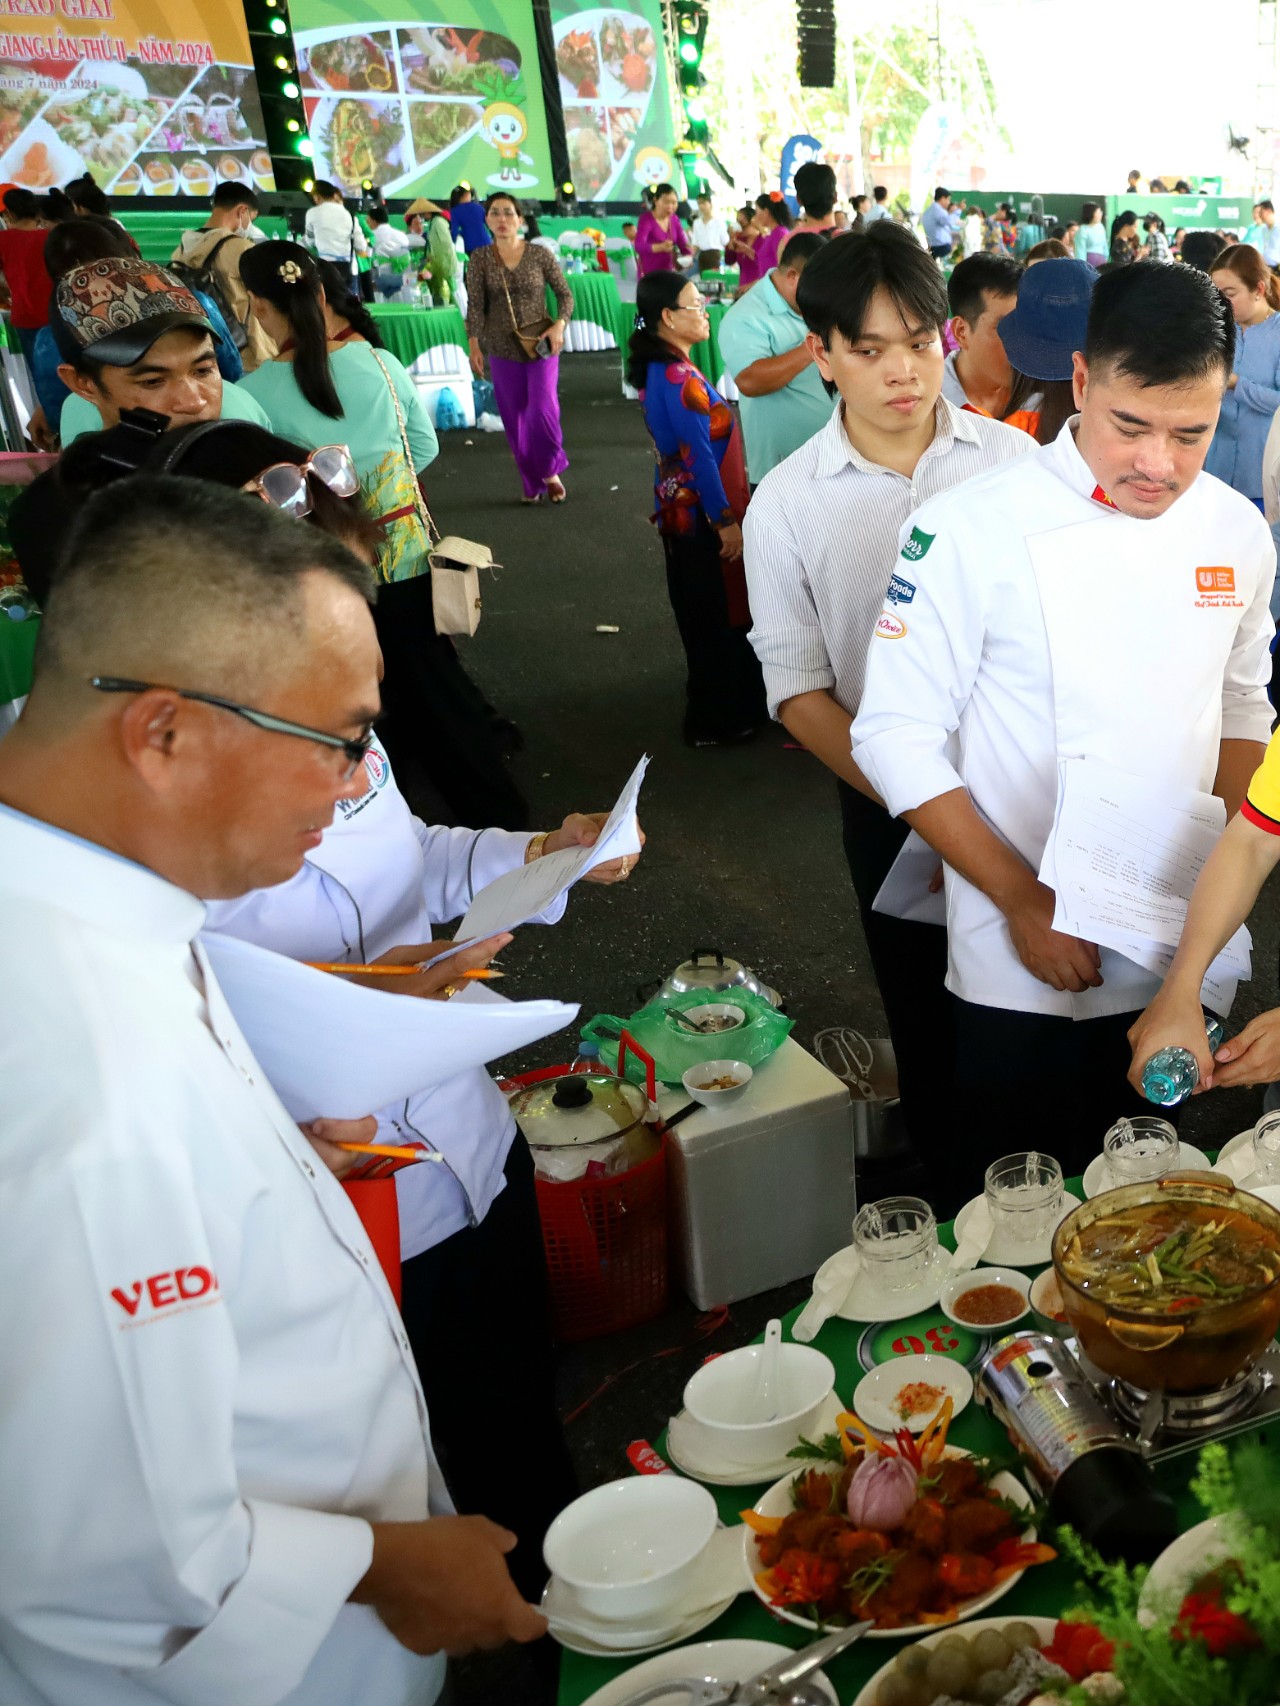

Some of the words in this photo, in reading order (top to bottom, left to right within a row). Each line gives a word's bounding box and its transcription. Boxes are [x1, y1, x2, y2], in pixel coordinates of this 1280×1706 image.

[80, 32, 112, 62] THỨ
[115, 40, 127, 62] II
[138, 36, 175, 64] NĂM
[177, 43, 214, 65] 2024
[70, 79, 98, 90] 2024
[111, 1265, 219, 1316] VED
